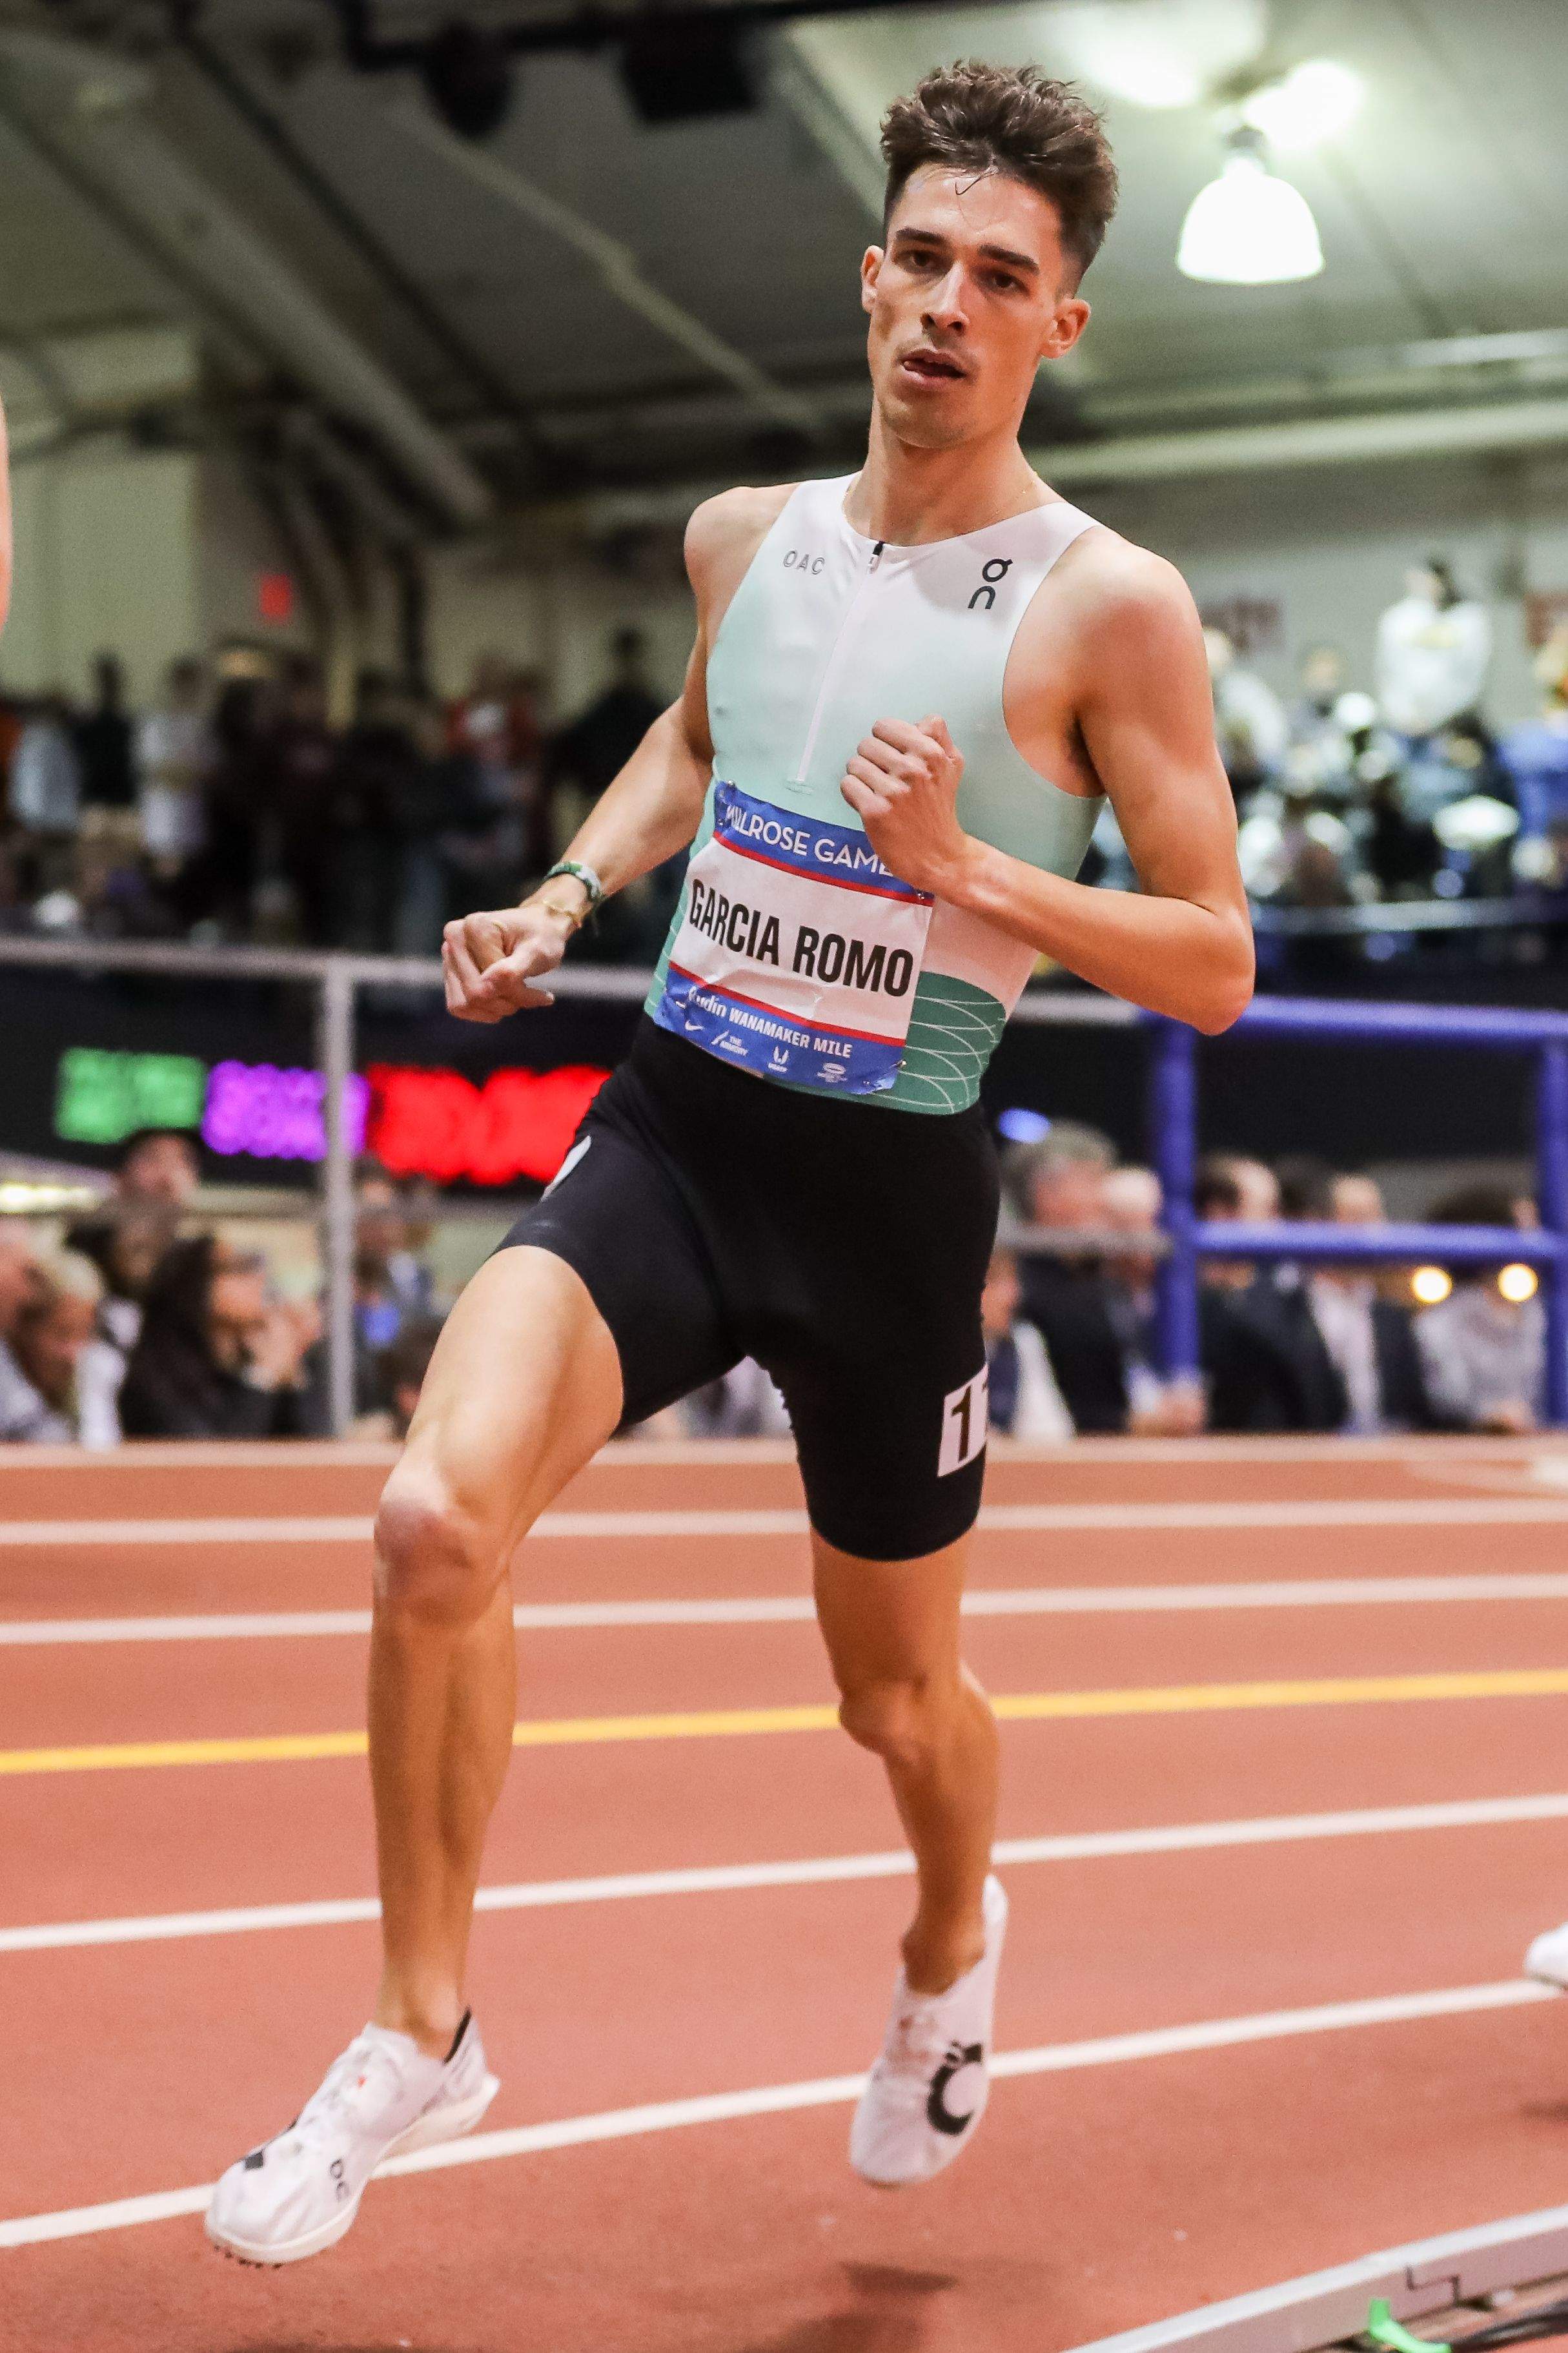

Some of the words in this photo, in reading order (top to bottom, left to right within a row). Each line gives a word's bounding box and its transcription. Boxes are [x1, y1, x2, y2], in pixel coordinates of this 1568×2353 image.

[783, 550, 825, 575] OAC
[815, 838, 894, 877] GAME
[689, 879, 780, 966] GARCIA
[792, 925, 914, 997] ROMO
[728, 1007, 810, 1049] WANAMAKER
[813, 1037, 853, 1058] MILE
